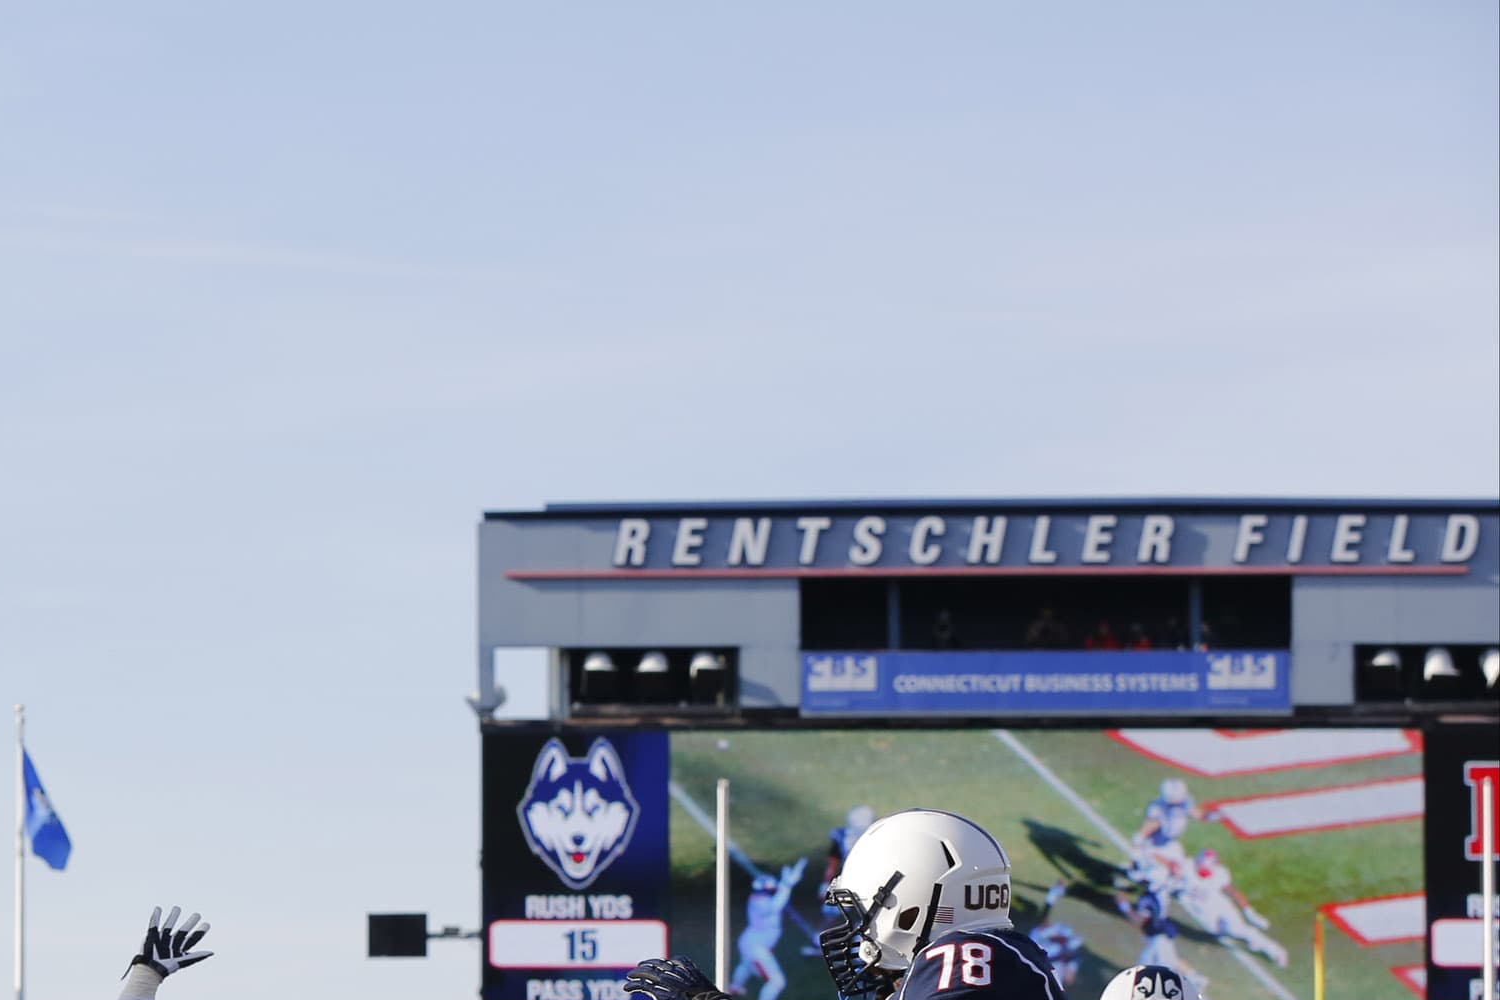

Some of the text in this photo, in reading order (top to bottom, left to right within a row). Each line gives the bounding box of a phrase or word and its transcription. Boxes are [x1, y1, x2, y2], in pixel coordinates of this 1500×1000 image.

[612, 514, 1481, 567] RENTSCHLER FIELD
[893, 673, 1199, 694] CONNECTICUT BUSINESS SYSTEMS
[525, 895, 634, 919] RUSH YDS
[564, 929, 598, 962] 15
[925, 942, 993, 992] 78
